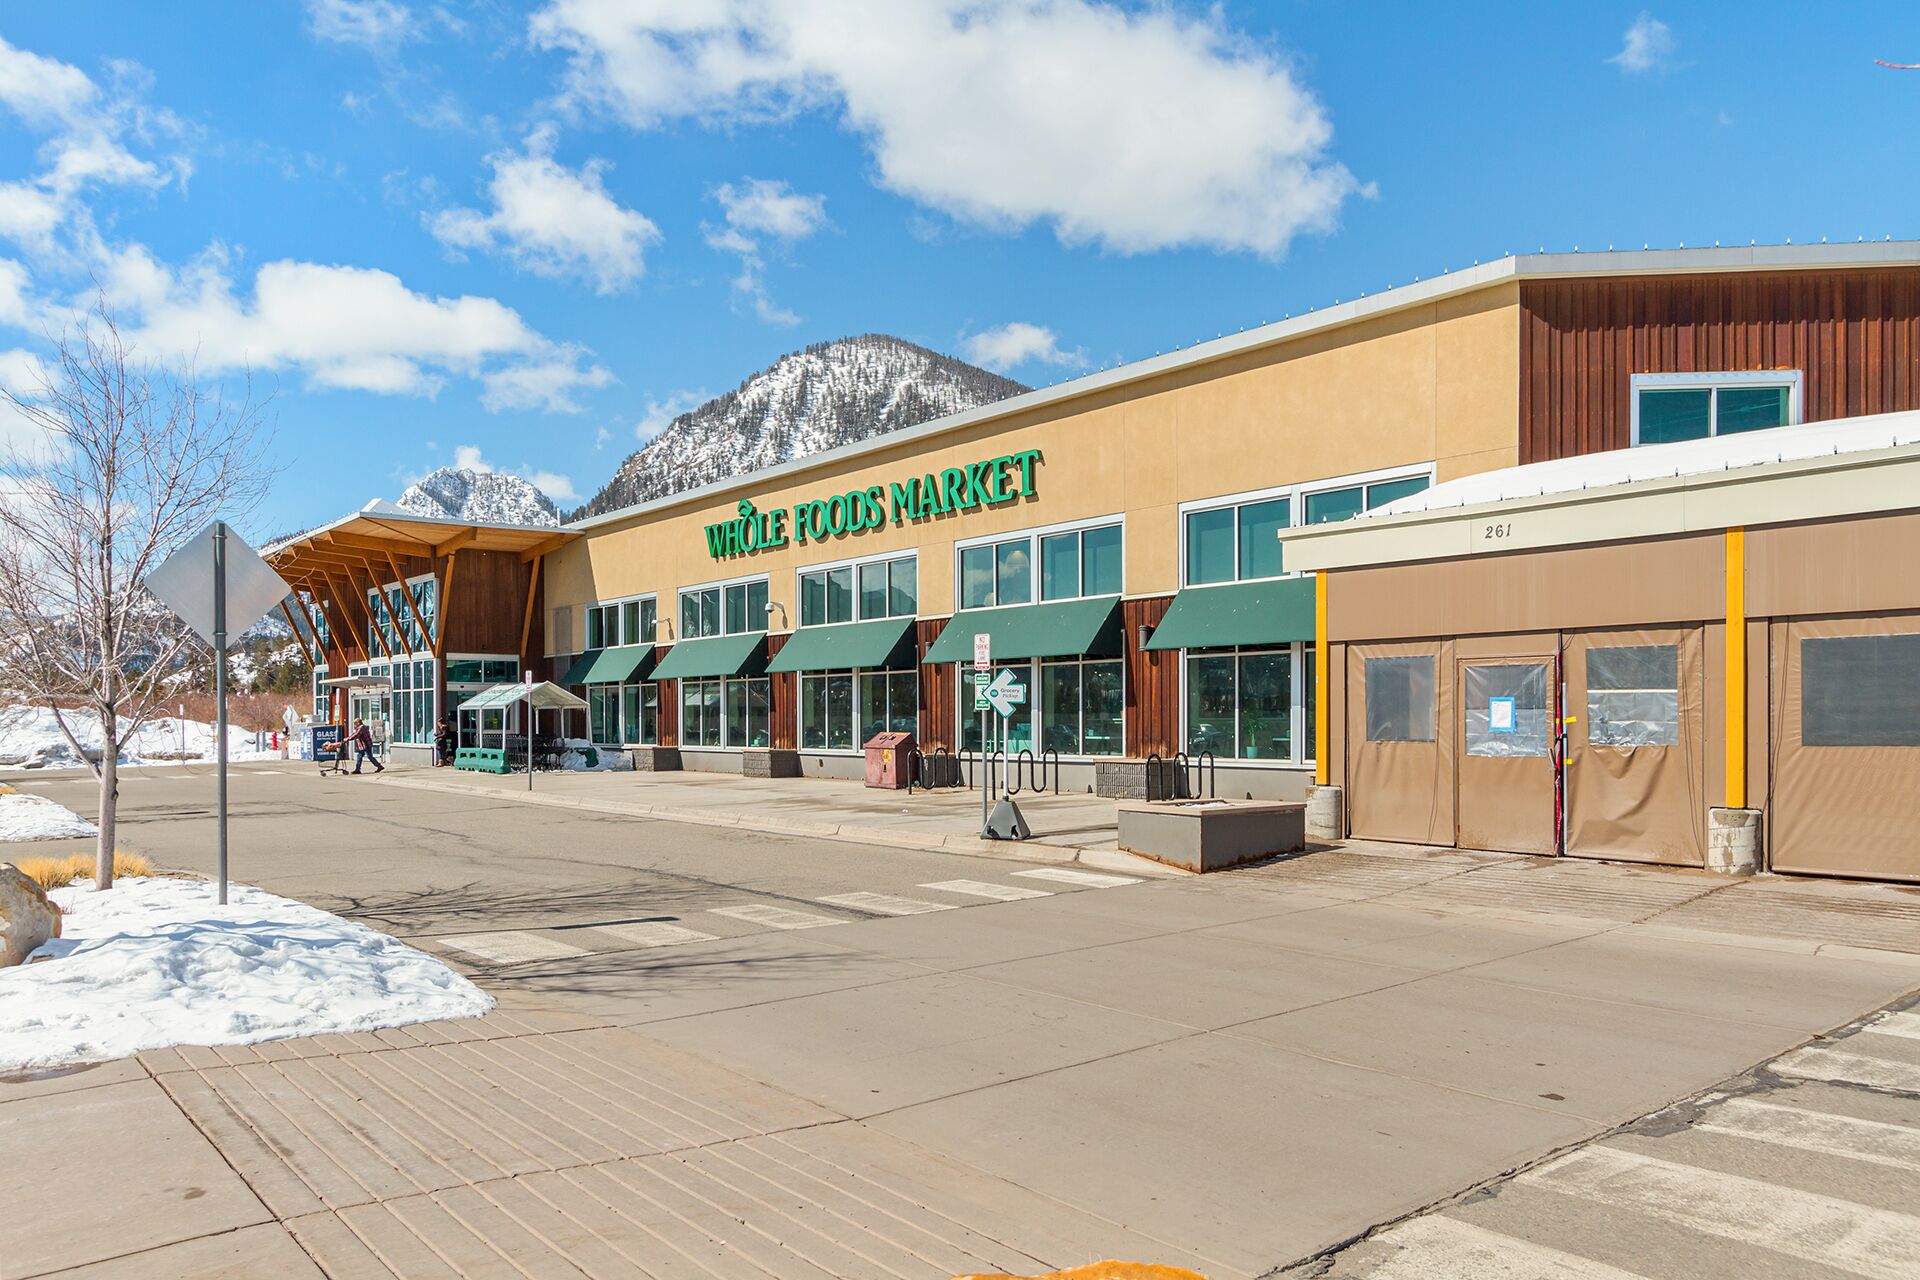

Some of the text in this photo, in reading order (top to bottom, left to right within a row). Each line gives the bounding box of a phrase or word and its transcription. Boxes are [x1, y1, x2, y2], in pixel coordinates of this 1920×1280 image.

[704, 449, 1042, 558] WHOLE FOODS MARKET
[1485, 523, 1511, 539] 261
